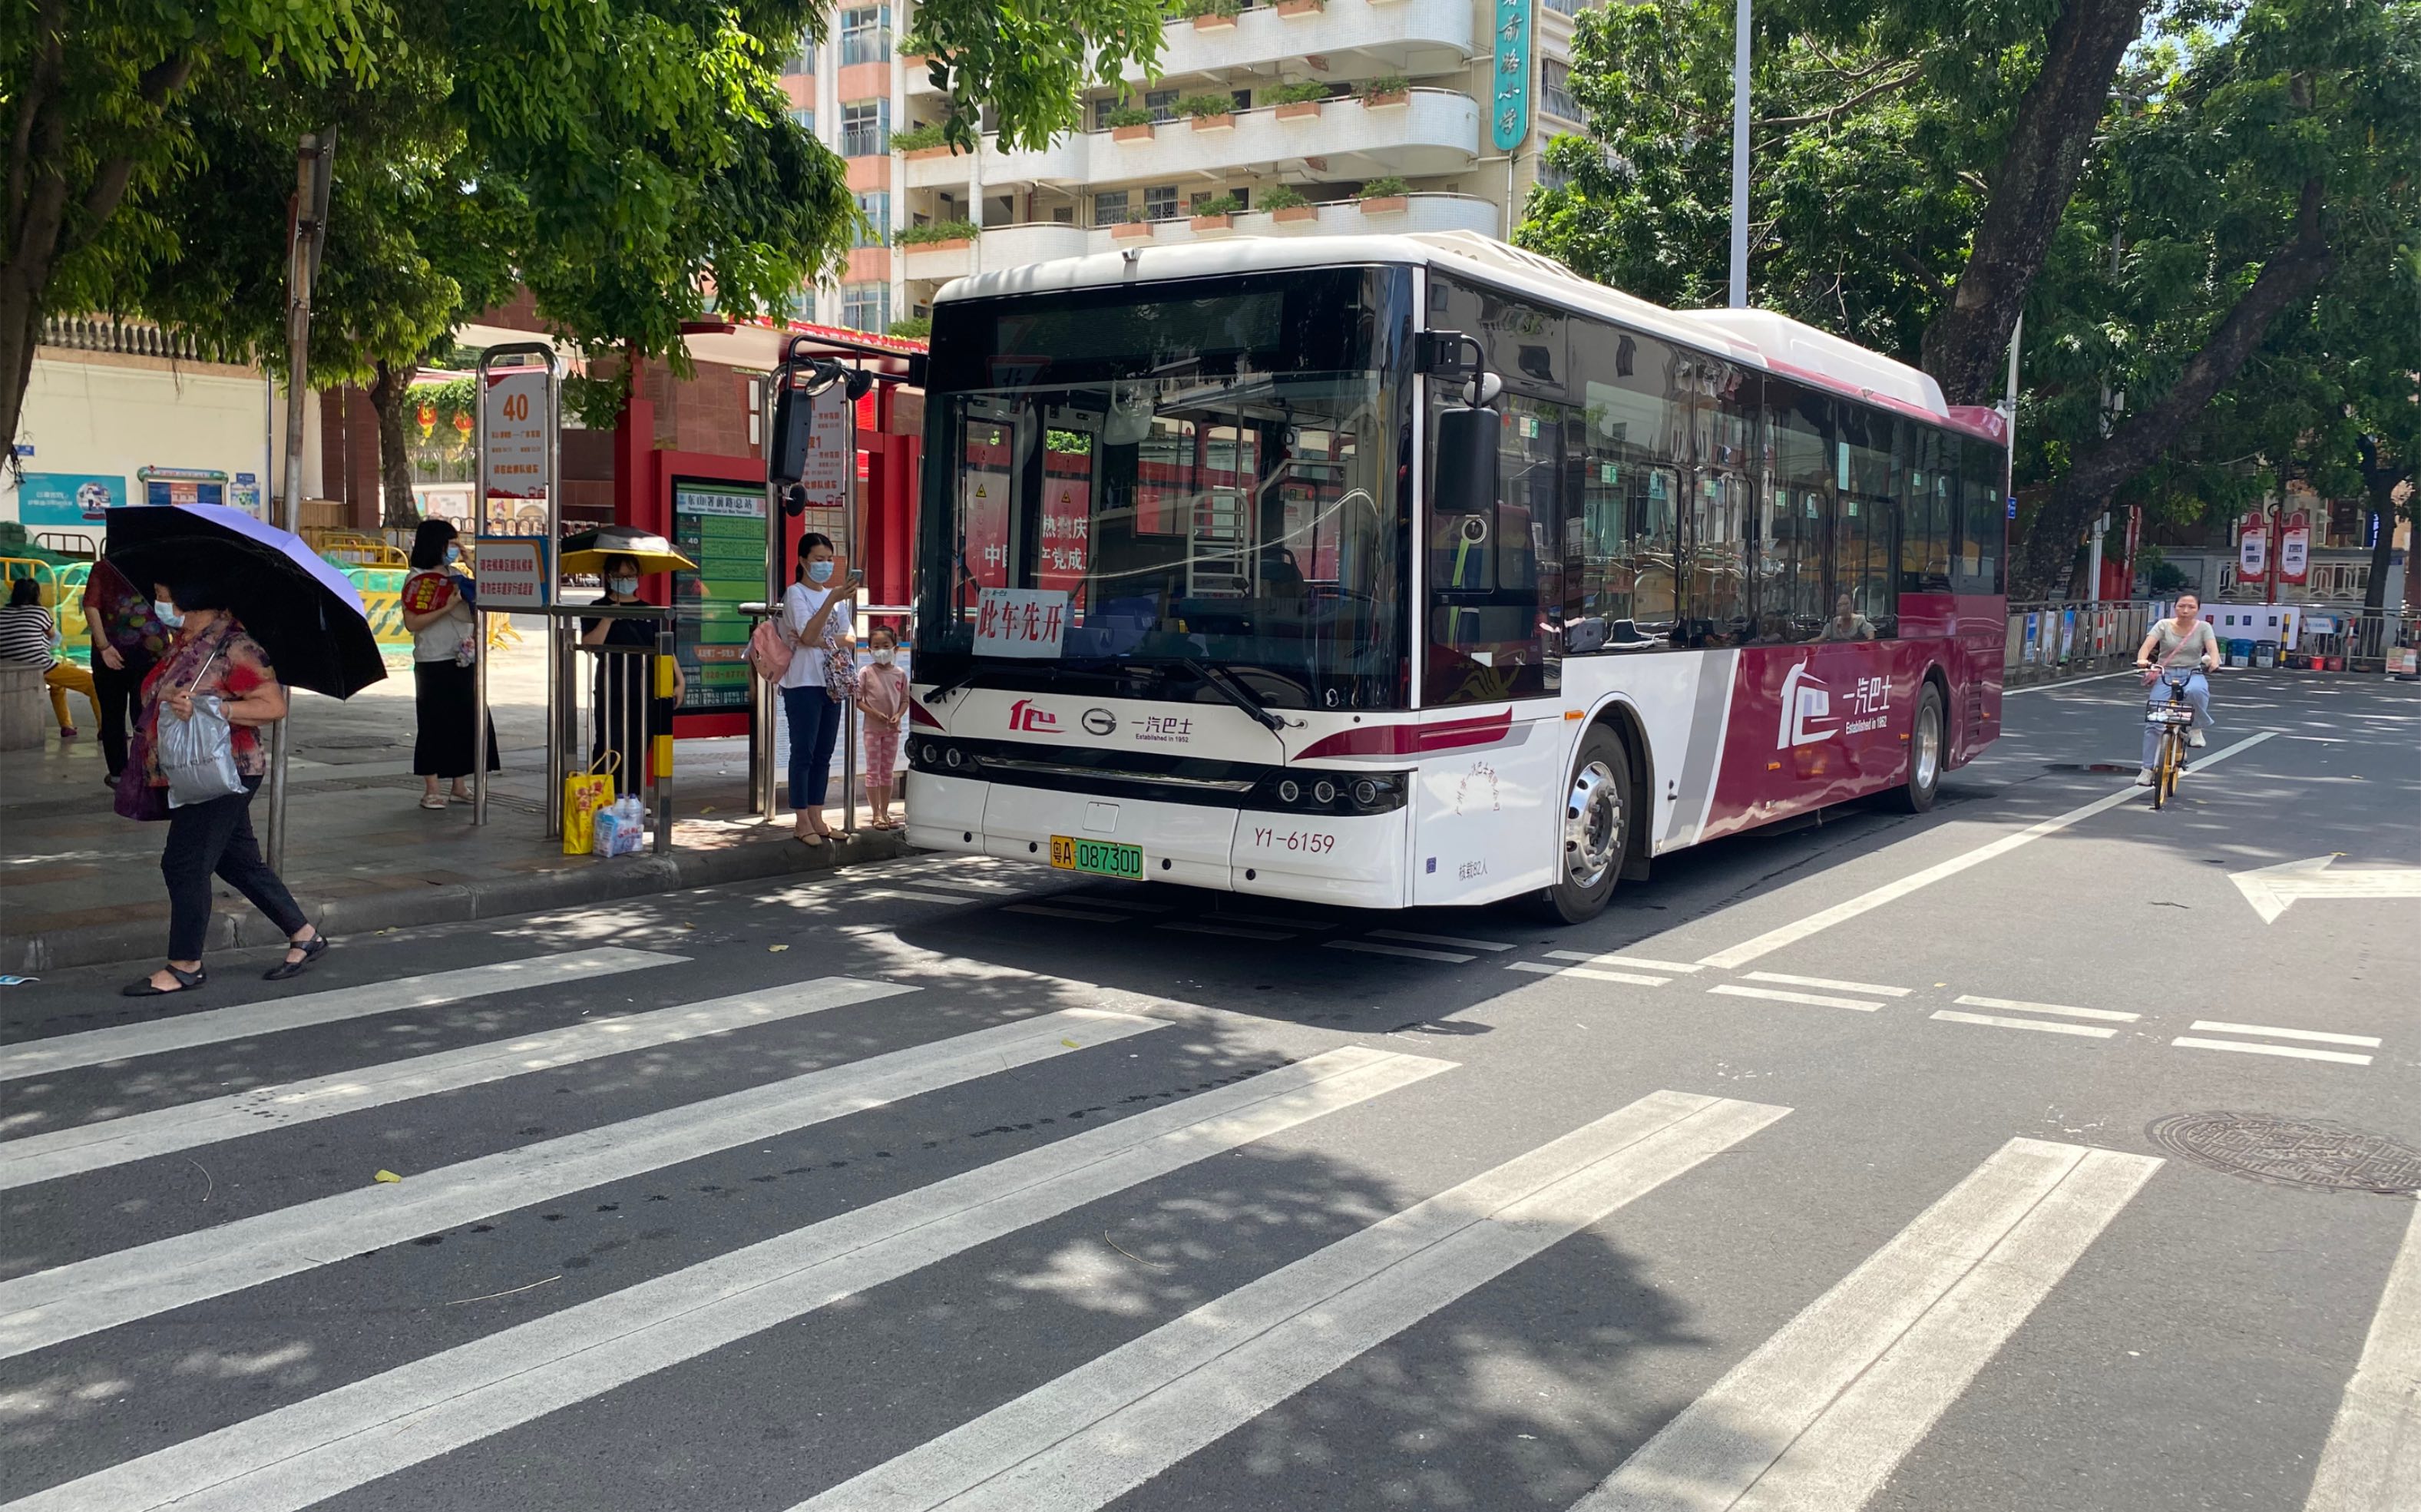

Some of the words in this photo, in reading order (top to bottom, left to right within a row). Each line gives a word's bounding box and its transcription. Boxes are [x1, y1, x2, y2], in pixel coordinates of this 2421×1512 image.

[503, 393, 528, 422] 40
[978, 600, 1063, 643] 此车先开
[1843, 675, 1892, 715] 一汽巴士
[1131, 716, 1193, 735] 一汽巴士
[1136, 733, 1168, 743] Established
[1845, 717, 1871, 735] Established
[1255, 827, 1335, 854] Y1-6159
[1459, 858, 1488, 881] 核载82人
